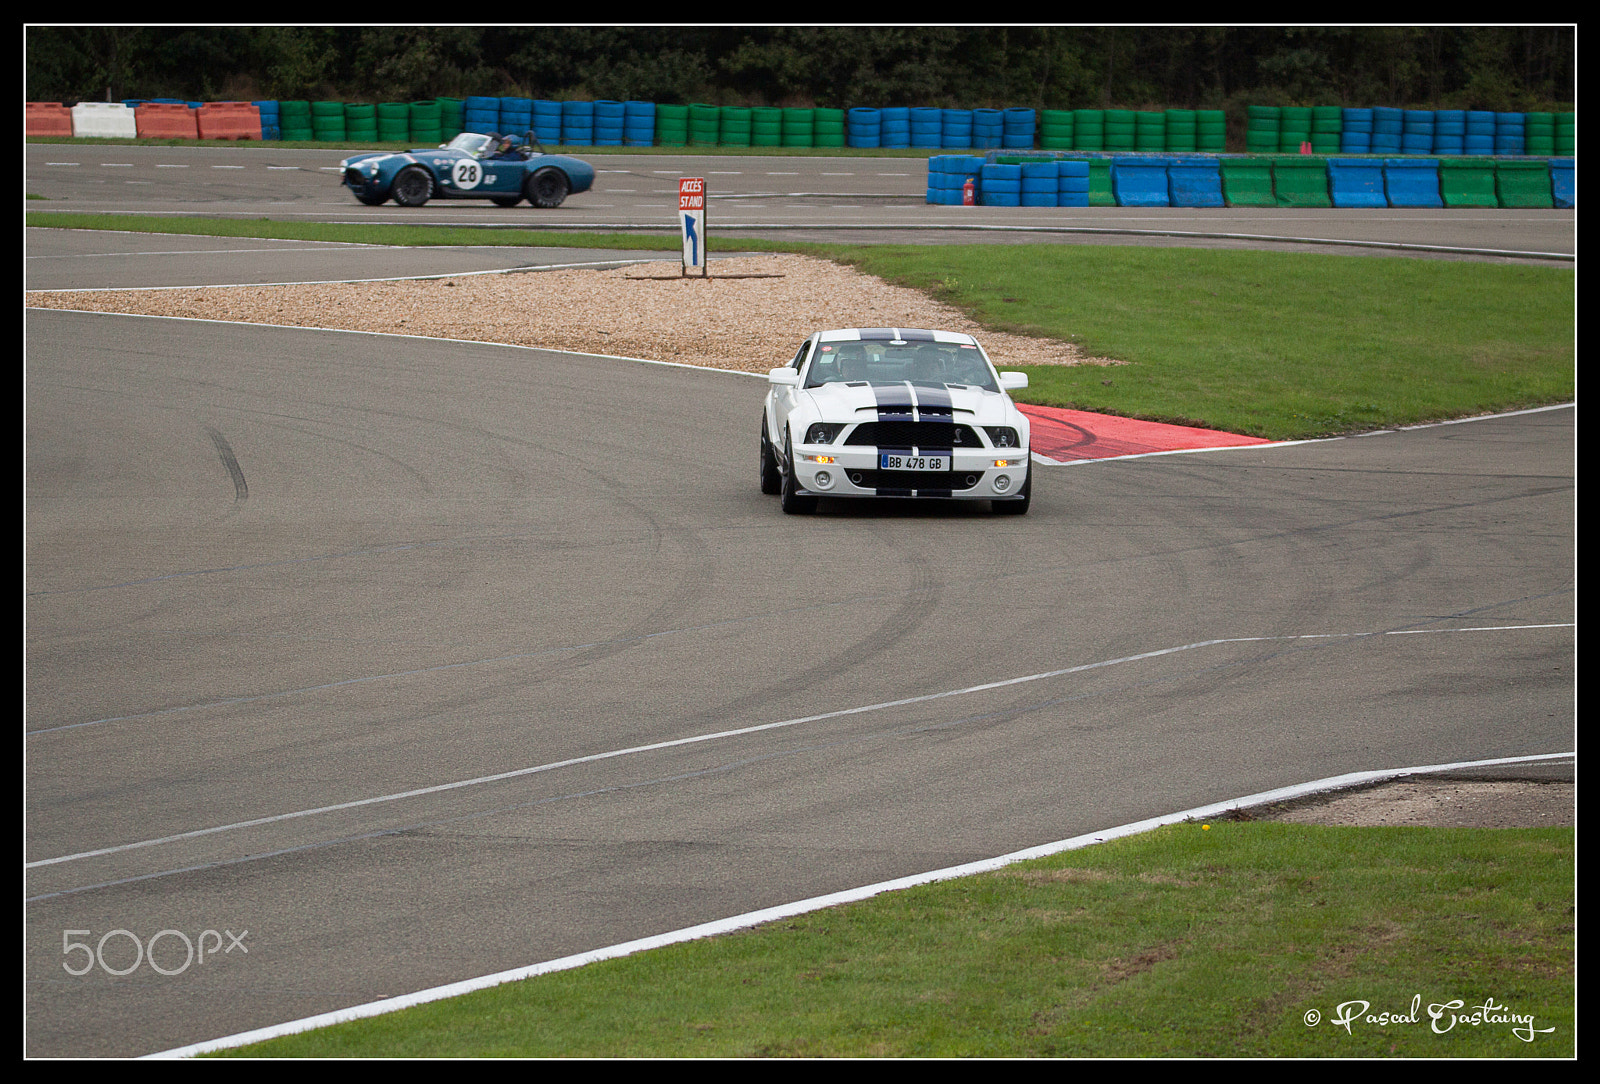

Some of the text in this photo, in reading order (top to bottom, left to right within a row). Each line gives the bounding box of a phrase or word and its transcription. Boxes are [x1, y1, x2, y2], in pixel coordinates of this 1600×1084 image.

[459, 165, 477, 182] 28
[681, 178, 702, 192] ACCÈS
[680, 196, 703, 207] STAND
[889, 456, 902, 468] BB
[906, 458, 925, 469] 478
[929, 459, 942, 469] GB
